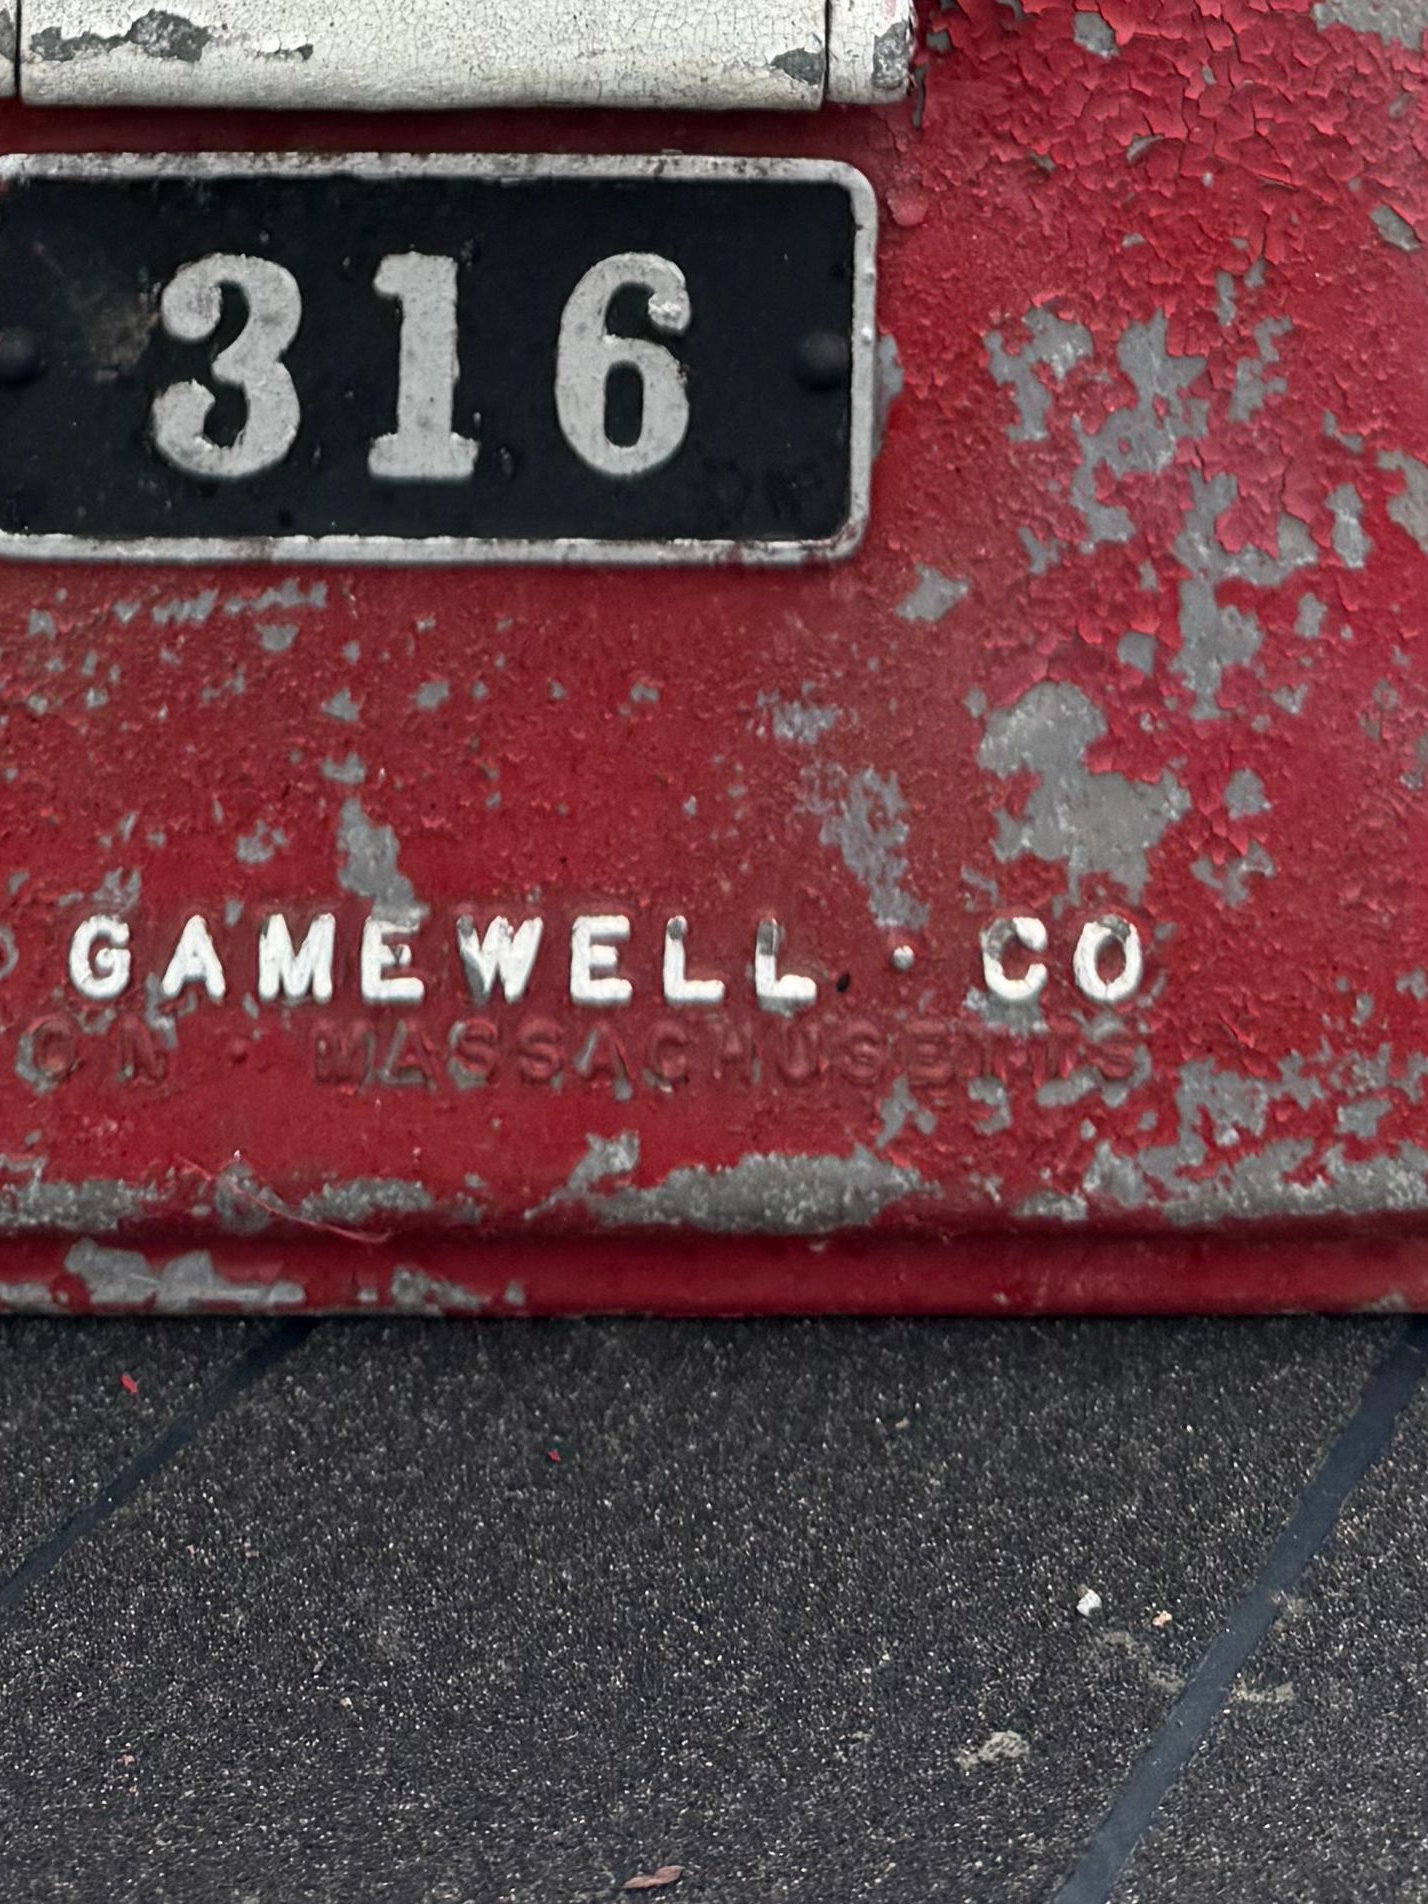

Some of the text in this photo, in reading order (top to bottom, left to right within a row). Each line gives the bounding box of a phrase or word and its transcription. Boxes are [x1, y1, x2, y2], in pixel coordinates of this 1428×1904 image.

[153, 251, 692, 480] 316
[68, 911, 818, 1006] GAMEWELL
[981, 914, 1144, 1003] CO
